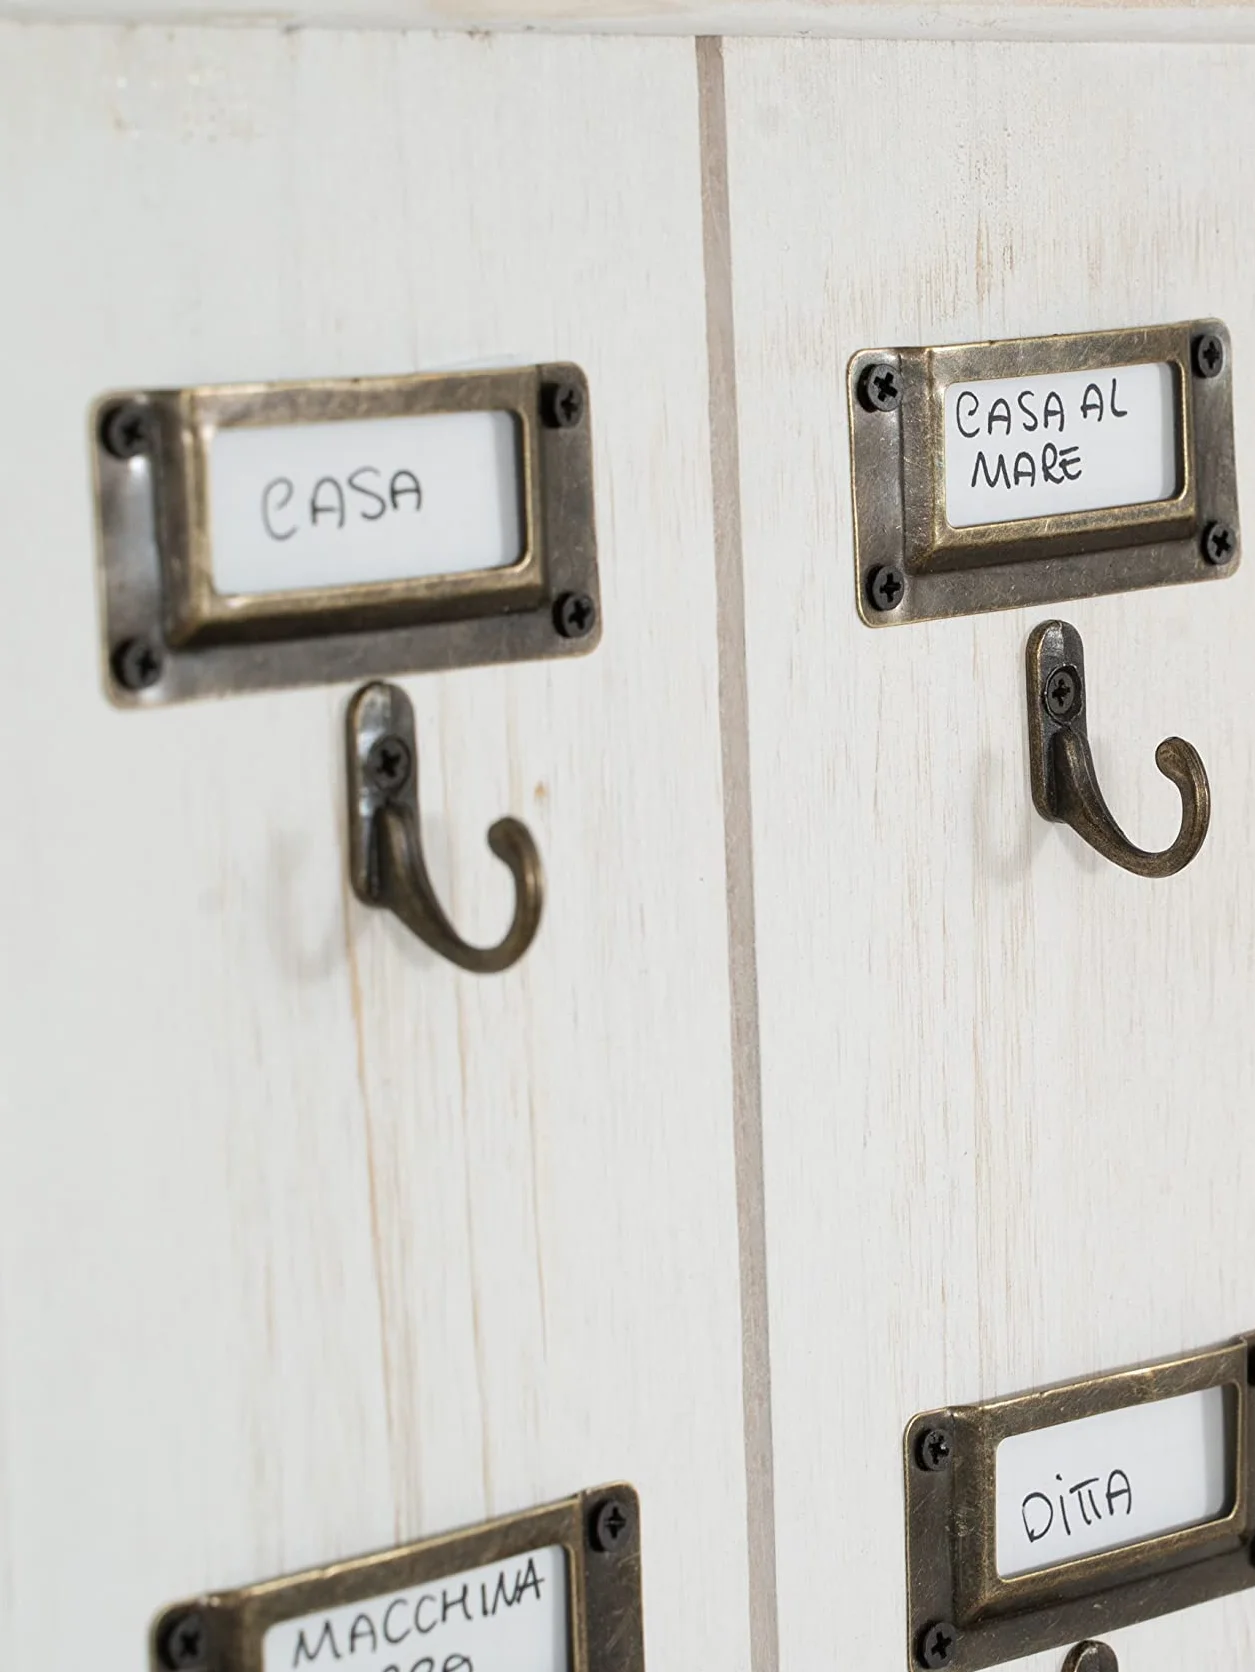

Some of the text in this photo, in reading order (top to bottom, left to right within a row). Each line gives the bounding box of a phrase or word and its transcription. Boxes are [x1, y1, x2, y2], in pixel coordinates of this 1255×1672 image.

[956, 378, 1128, 439] CASA AL
[970, 442, 1083, 490] MARE
[261, 465, 422, 542] CASA
[293, 1557, 545, 1669] MACCHINA
